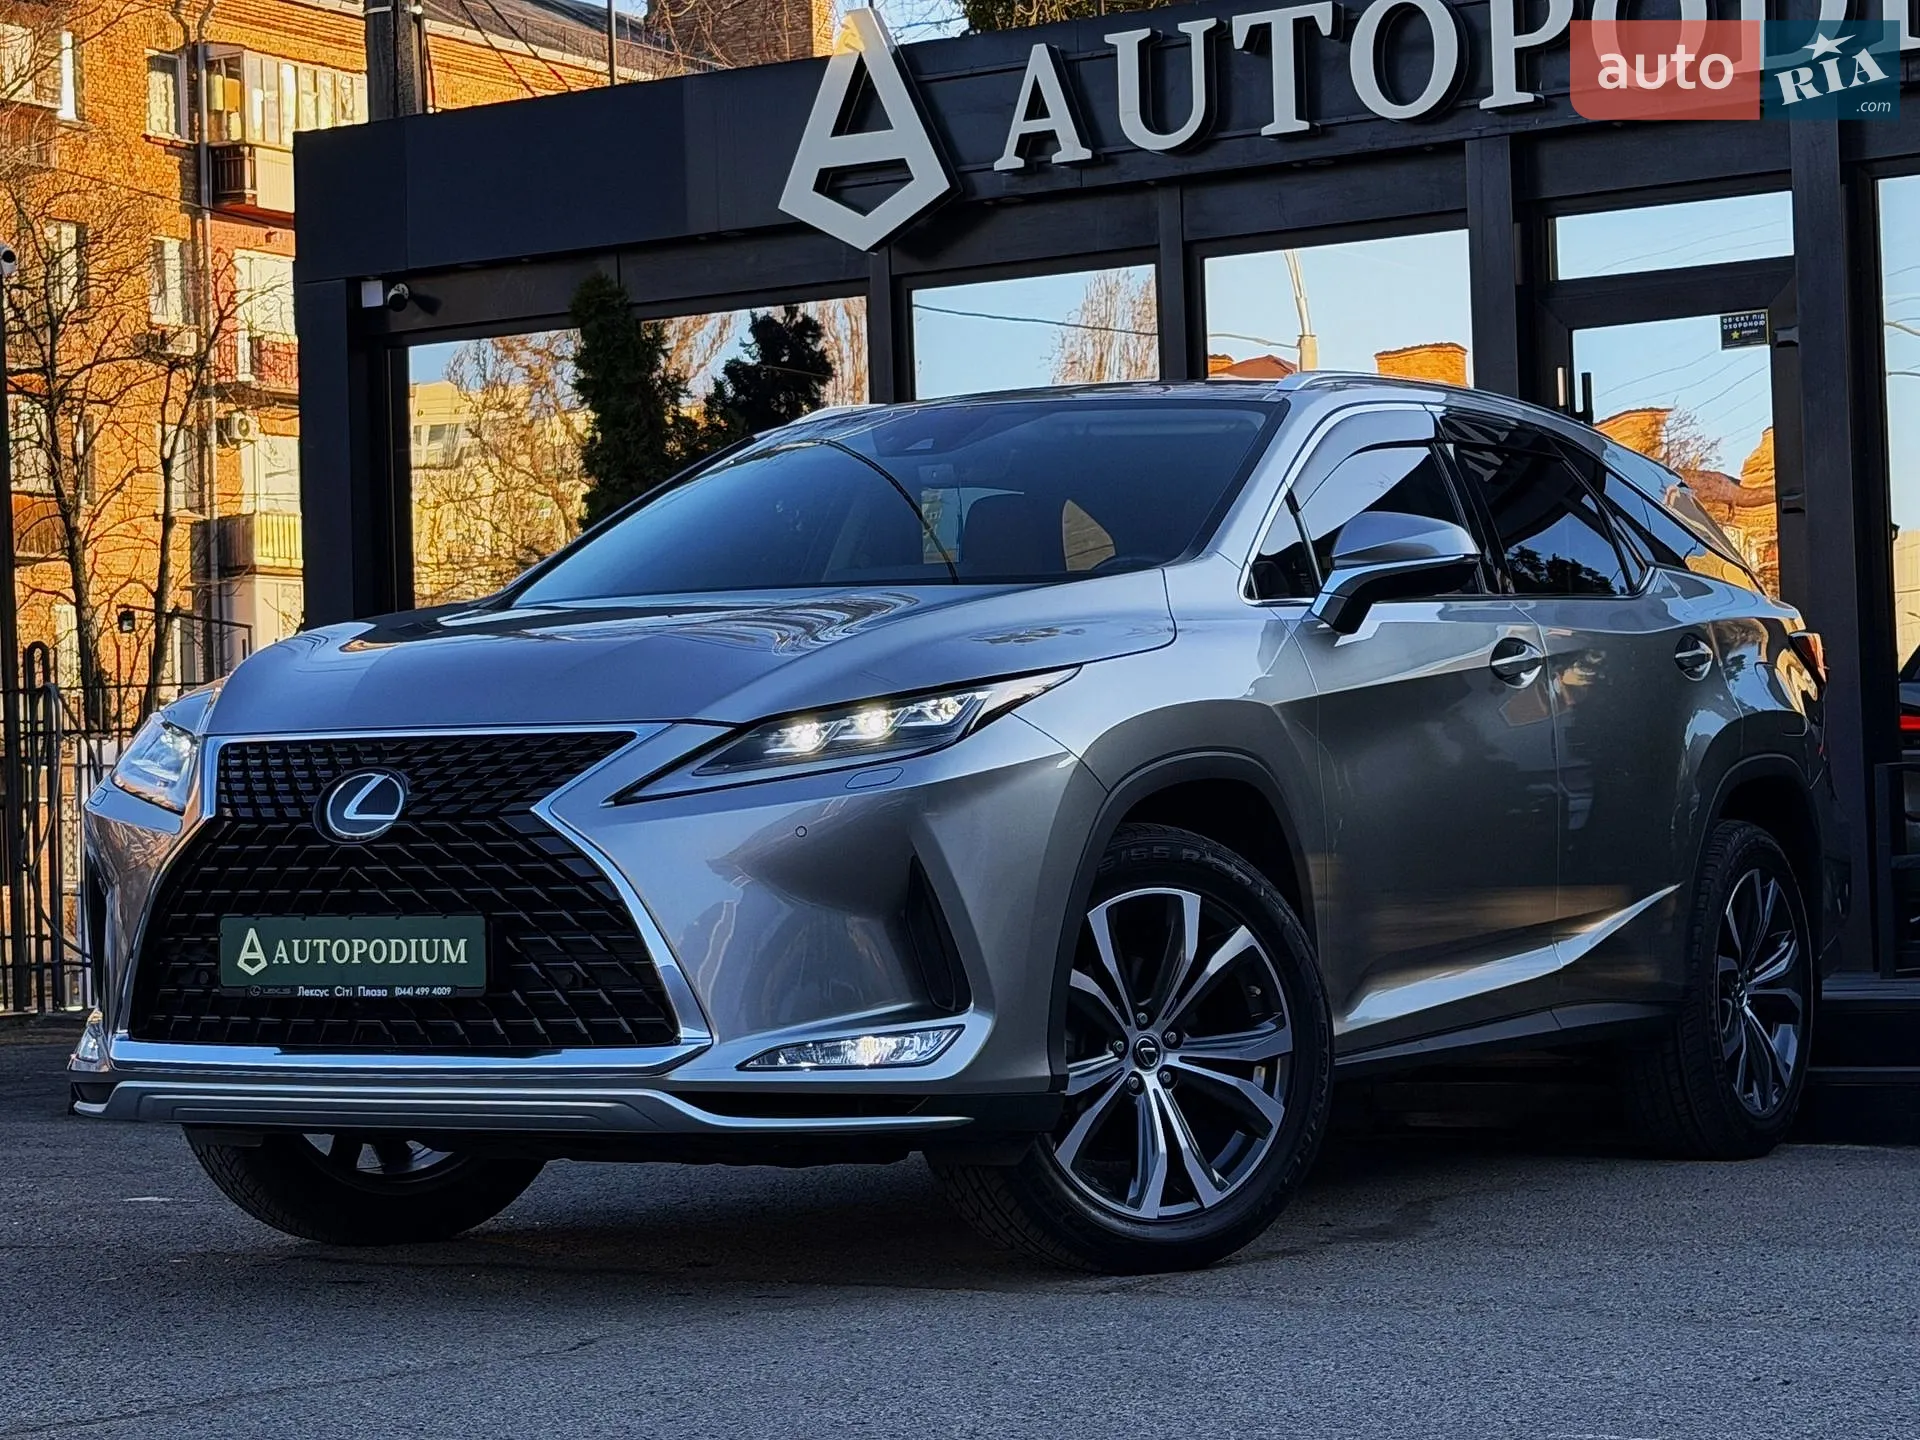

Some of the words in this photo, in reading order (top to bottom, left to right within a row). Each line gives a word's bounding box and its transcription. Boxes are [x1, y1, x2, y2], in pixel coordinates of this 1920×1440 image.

[272, 938, 468, 965] AUTOPODIUM
[296, 986, 330, 998] Лексус
[415, 987, 430, 997] 499
[432, 986, 452, 997] 4009
